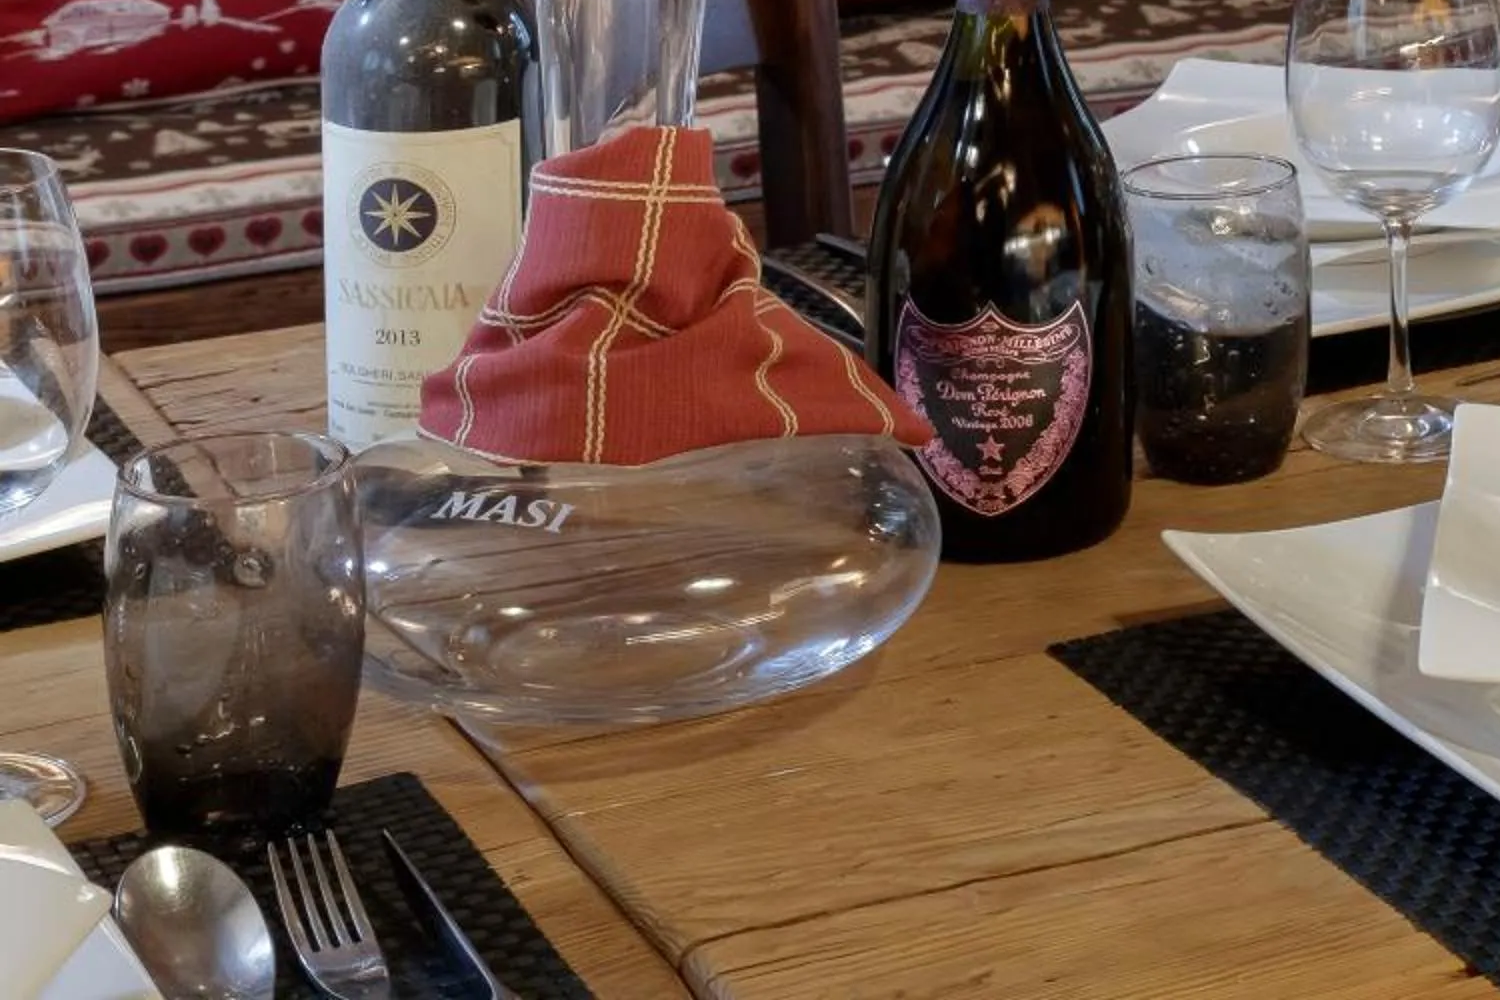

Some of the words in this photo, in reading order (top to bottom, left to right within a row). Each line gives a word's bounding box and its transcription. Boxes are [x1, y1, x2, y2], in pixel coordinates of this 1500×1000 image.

[338, 277, 470, 311] SASSICAIA
[375, 328, 421, 346] 2013
[936, 380, 977, 401] Dom
[429, 490, 577, 534] MASI
